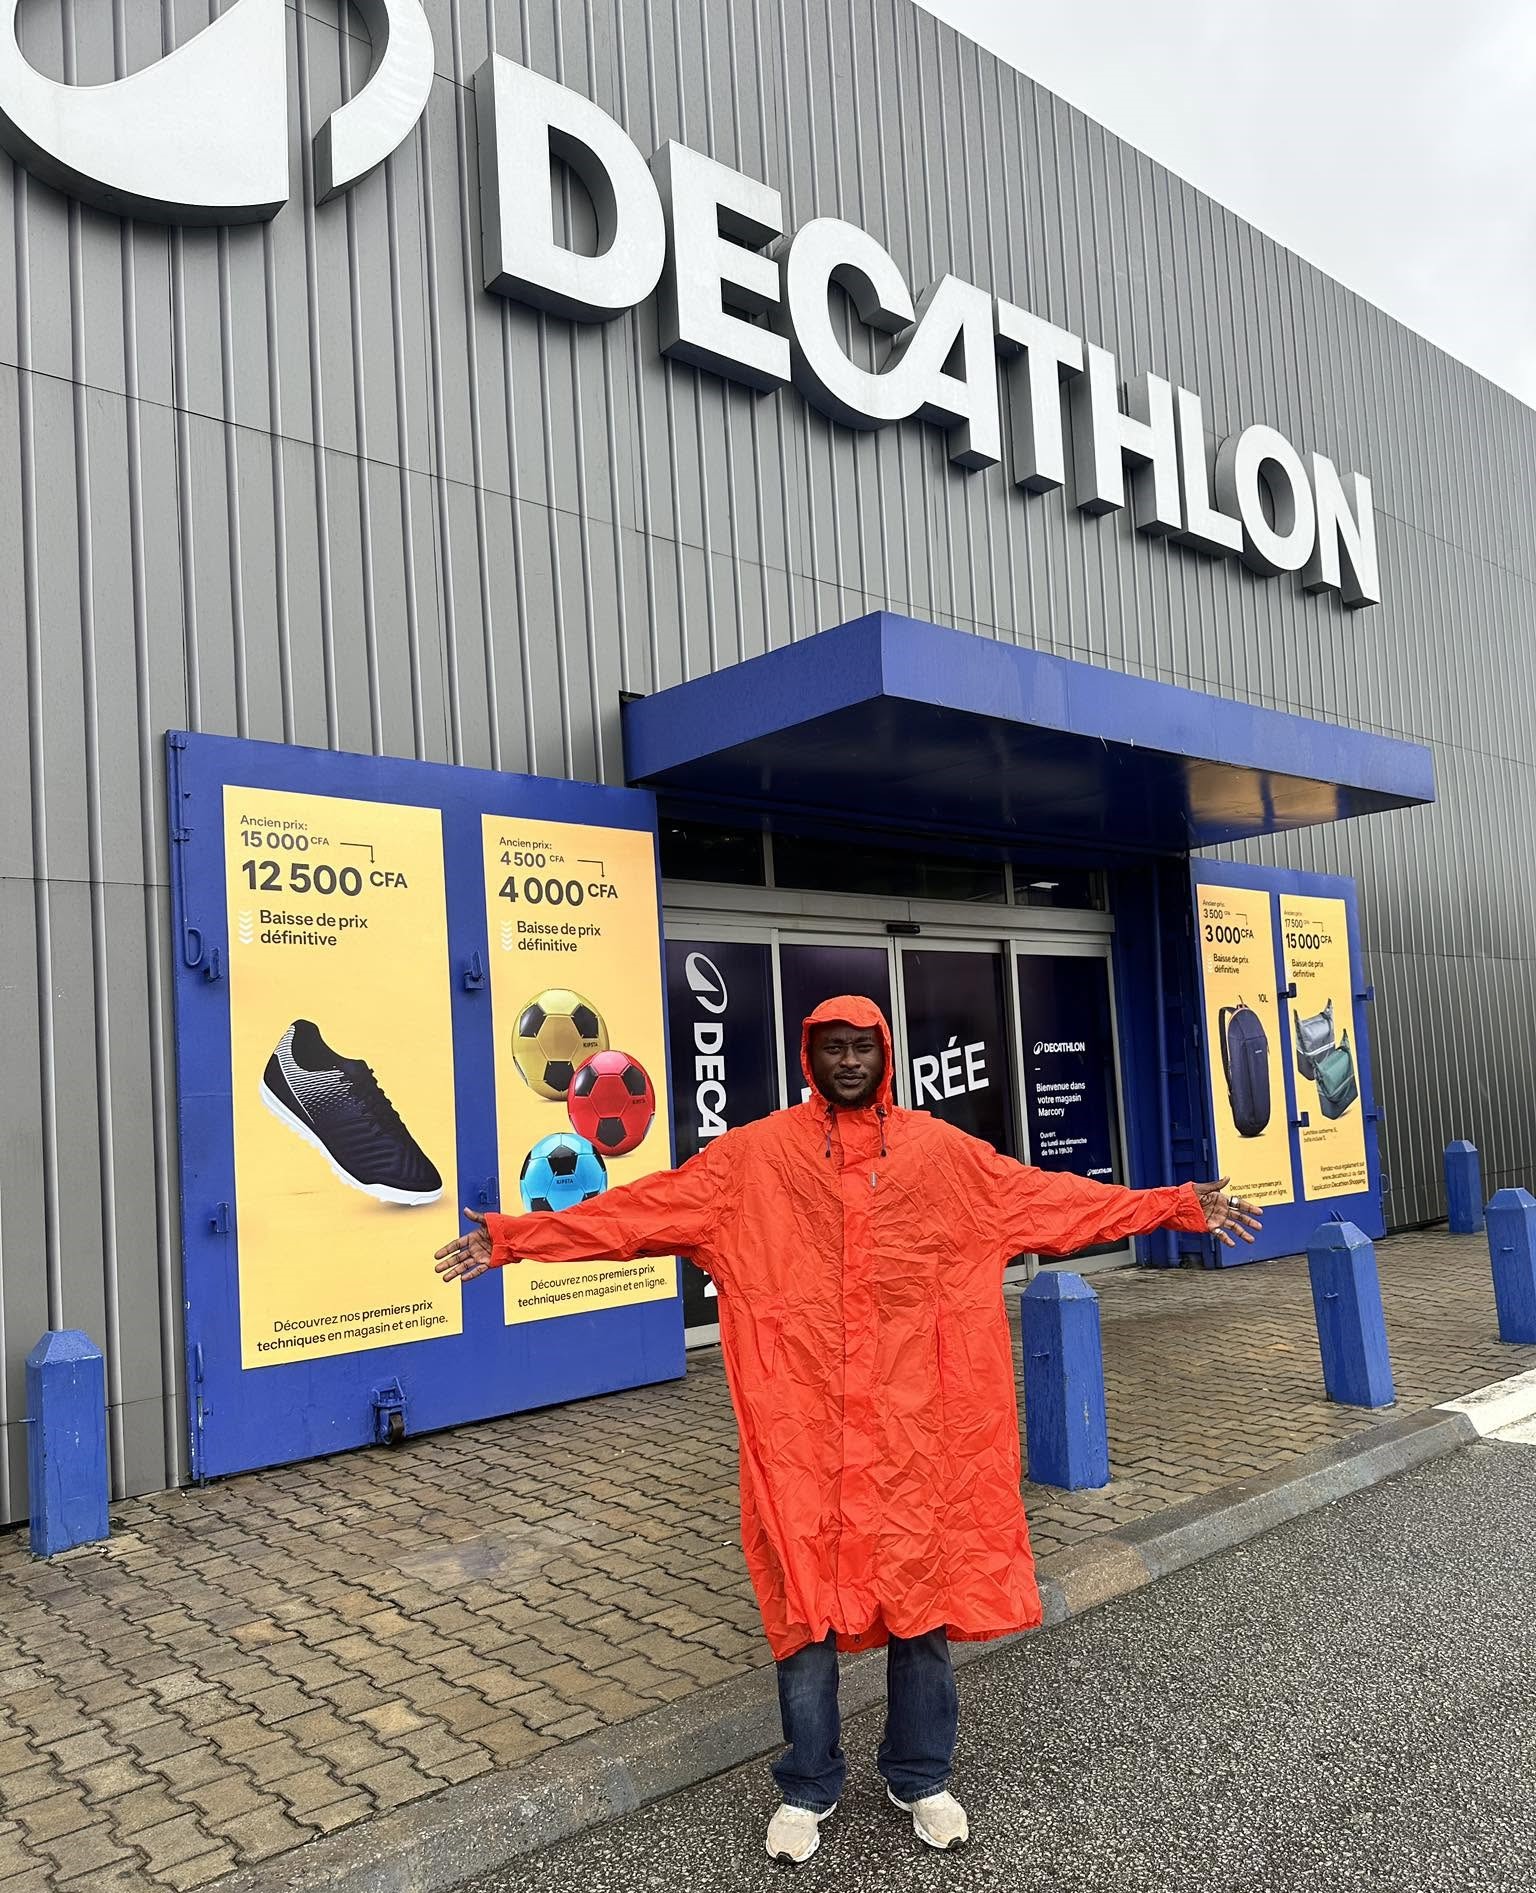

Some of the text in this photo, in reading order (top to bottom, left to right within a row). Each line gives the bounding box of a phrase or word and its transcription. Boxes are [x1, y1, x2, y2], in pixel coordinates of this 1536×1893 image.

[474, 52, 1380, 610] DECATHLON
[239, 814, 309, 832] Ancien prix:
[310, 836, 330, 846] CFA
[498, 835, 553, 851] Ancien prix:
[549, 854, 565, 863] CFA
[369, 870, 409, 889] CFA
[587, 883, 619, 899] CFA
[259, 909, 370, 931] Baisse de prix
[516, 920, 602, 939] Baisse de prix
[1240, 928, 1255, 940] CFA
[259, 929, 338, 947] définitive
[517, 937, 579, 953] définitive
[1320, 935, 1333, 945] CFA
[1213, 952, 1249, 966] Baisse de prix
[1291, 958, 1324, 969] Baisse de prix
[1214, 964, 1240, 975] définitive
[582, 1041, 599, 1049] KIPSTA
[1043, 1041, 1086, 1054] DECATHLON
[693, 1022, 728, 1154] DECA
[1035, 1081, 1086, 1093] Bienvenue dans
[1037, 1092, 1082, 1105] votre magasin
[1037, 1107, 1065, 1118] Marcory
[1039, 1131, 1057, 1140] Ouvert
[1047, 1139, 1059, 1147] lundi
[1065, 1137, 1088, 1146] dimanche
[530, 1263, 656, 1291] Découvrez nos premiers prix
[517, 1276, 668, 1308] techniques en magasin et en ligne.
[273, 1299, 434, 1333] Découvrez nos premiers prix
[256, 1313, 449, 1353] techniques en magasin et en ligne.
